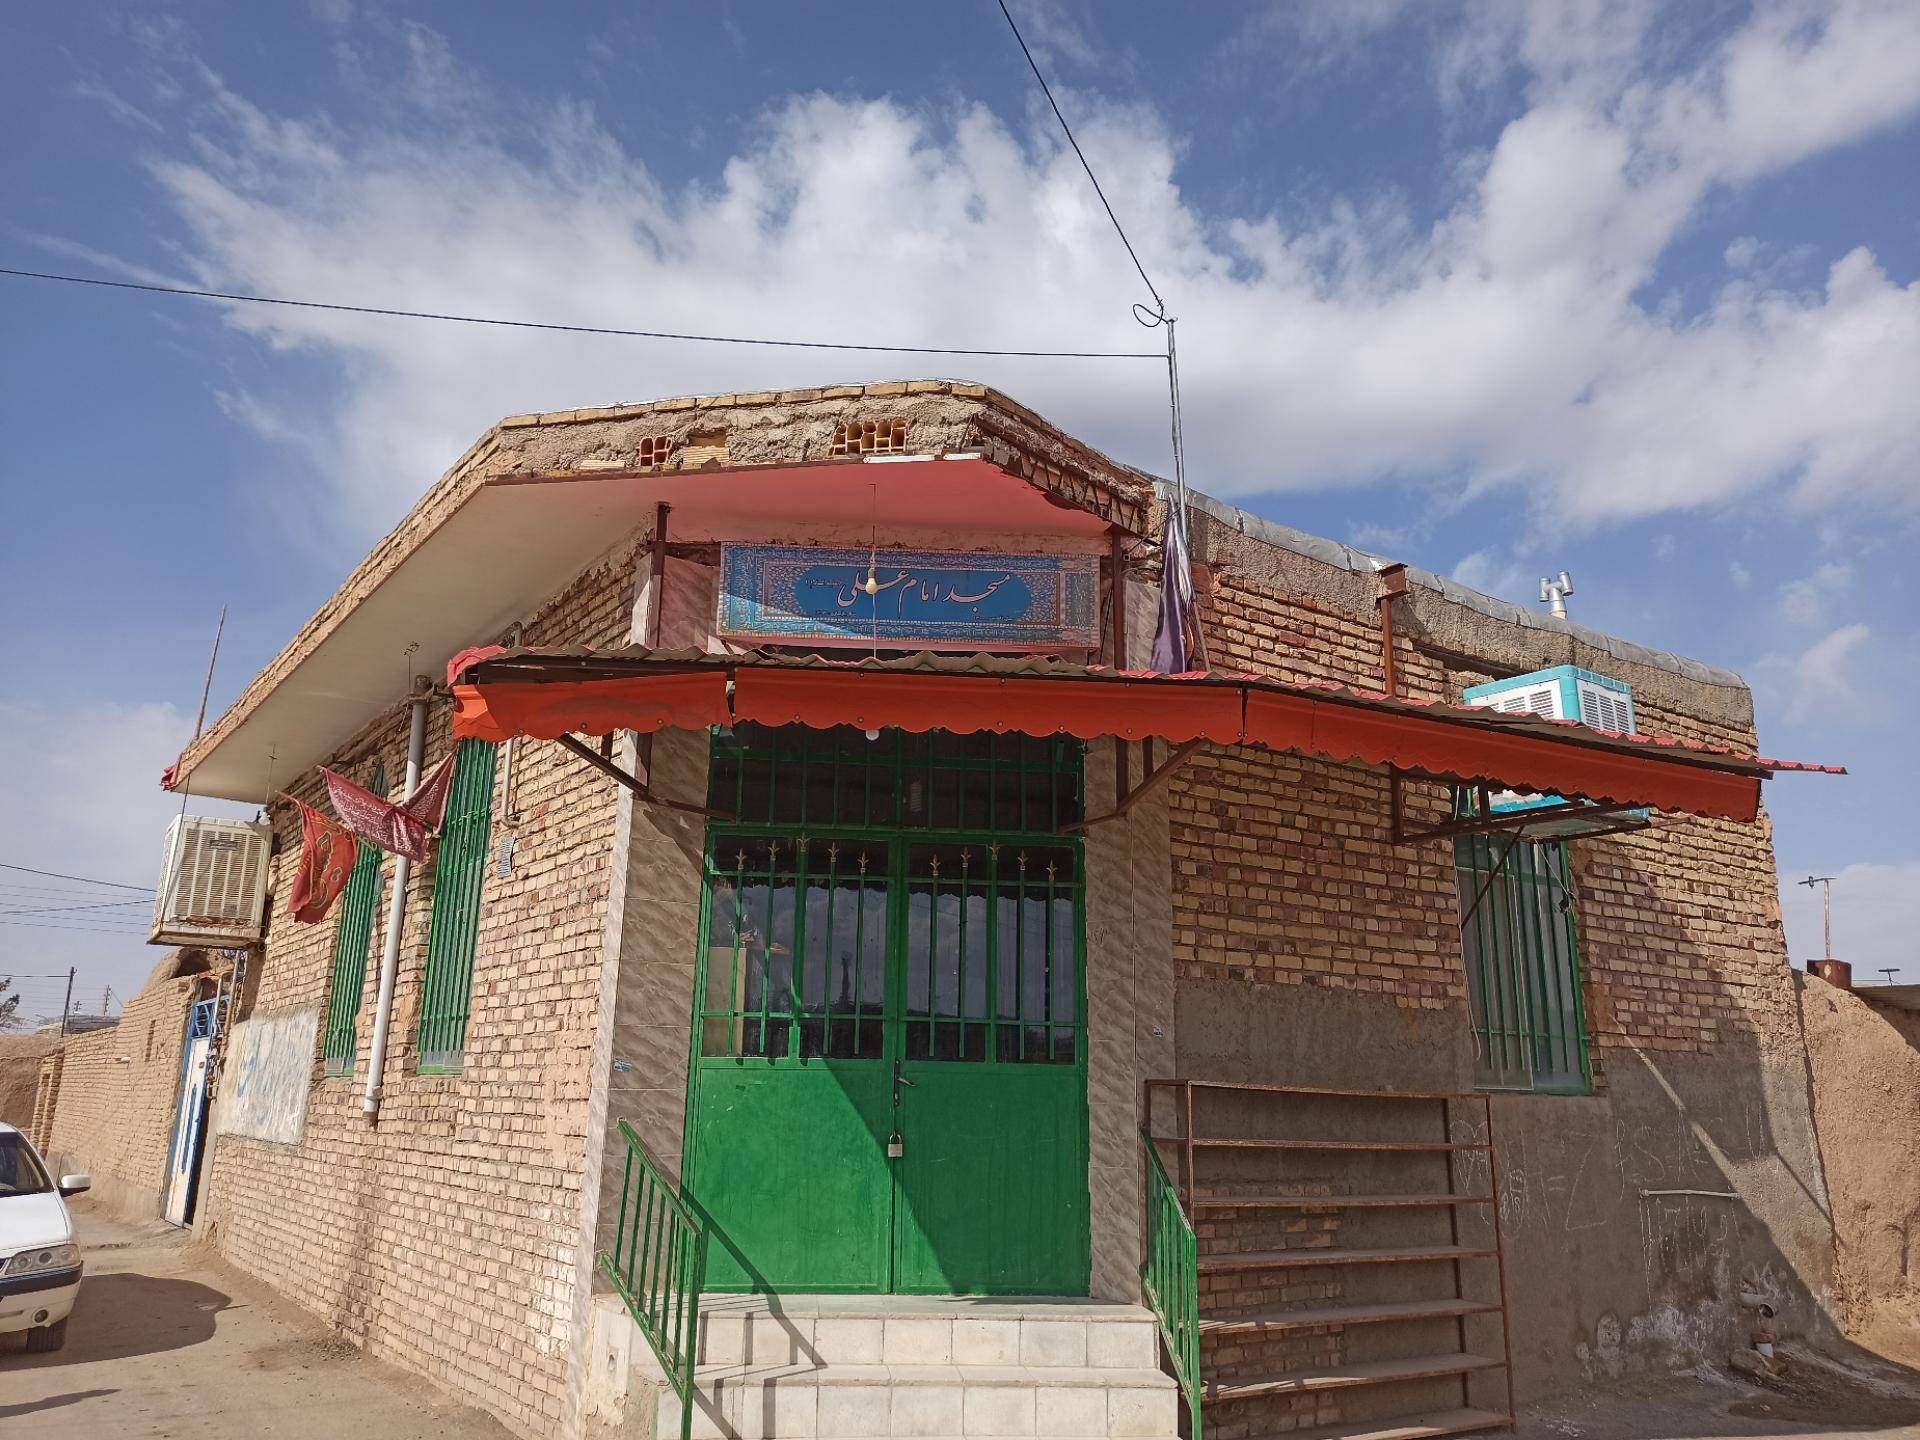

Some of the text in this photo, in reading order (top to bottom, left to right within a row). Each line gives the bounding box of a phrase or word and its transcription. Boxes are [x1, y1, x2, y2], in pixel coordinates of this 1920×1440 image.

[837, 569, 1011, 619] مسجد امام علی
